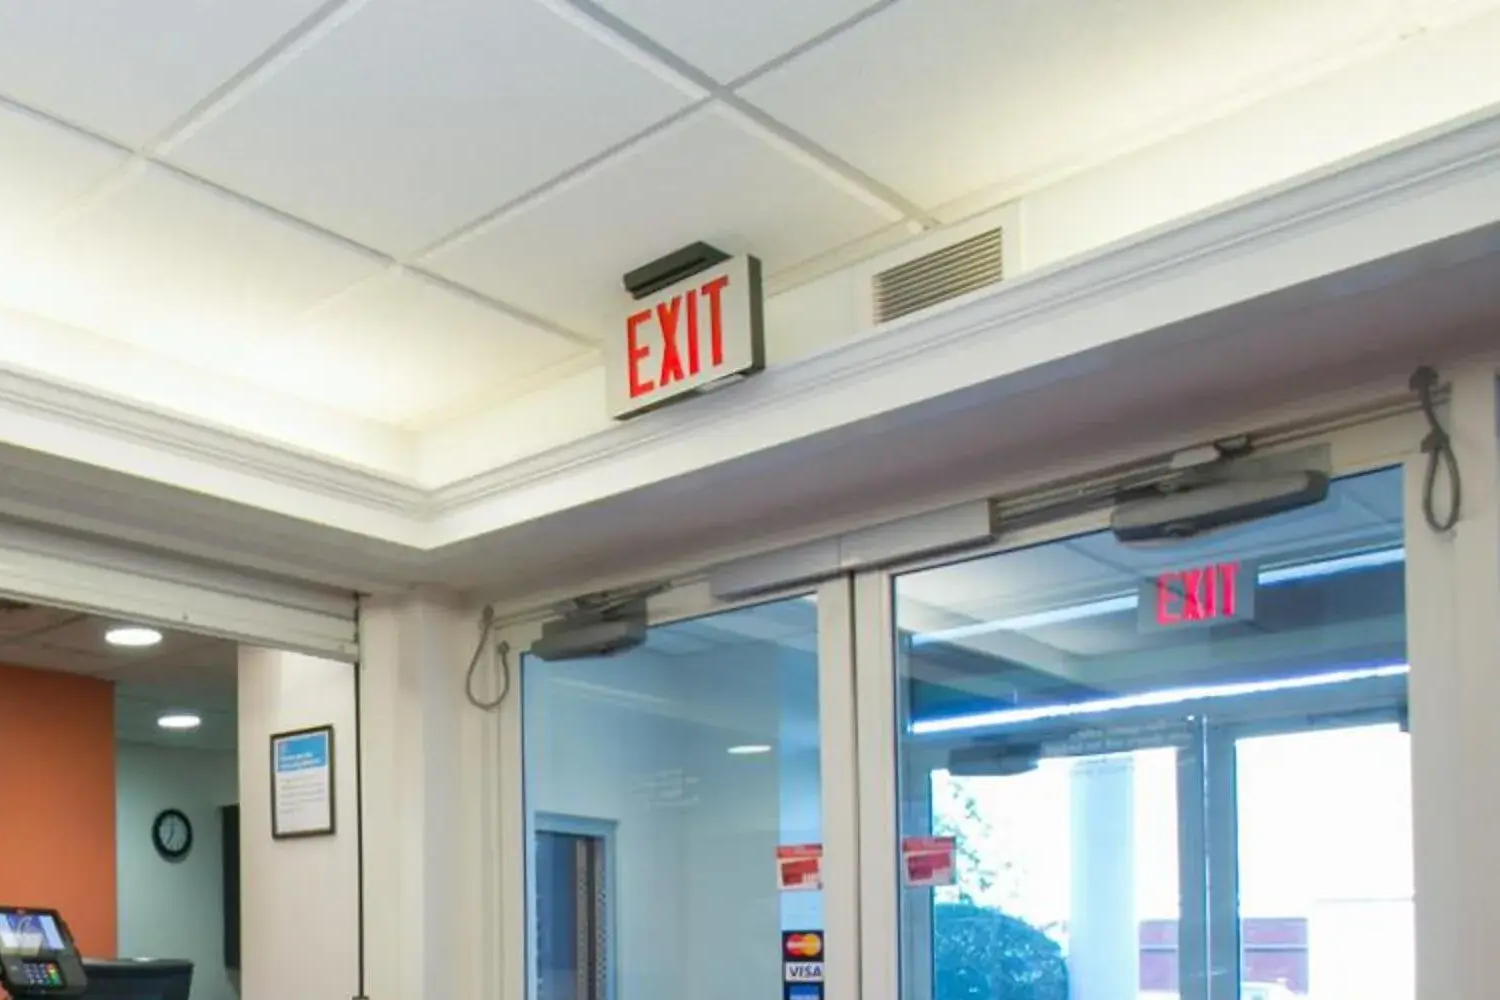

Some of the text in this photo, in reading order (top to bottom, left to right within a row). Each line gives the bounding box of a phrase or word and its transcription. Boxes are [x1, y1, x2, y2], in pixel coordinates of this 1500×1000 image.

[626, 275, 730, 398] EXIT
[1155, 561, 1240, 626] EXIT
[789, 965, 822, 977] VISA
